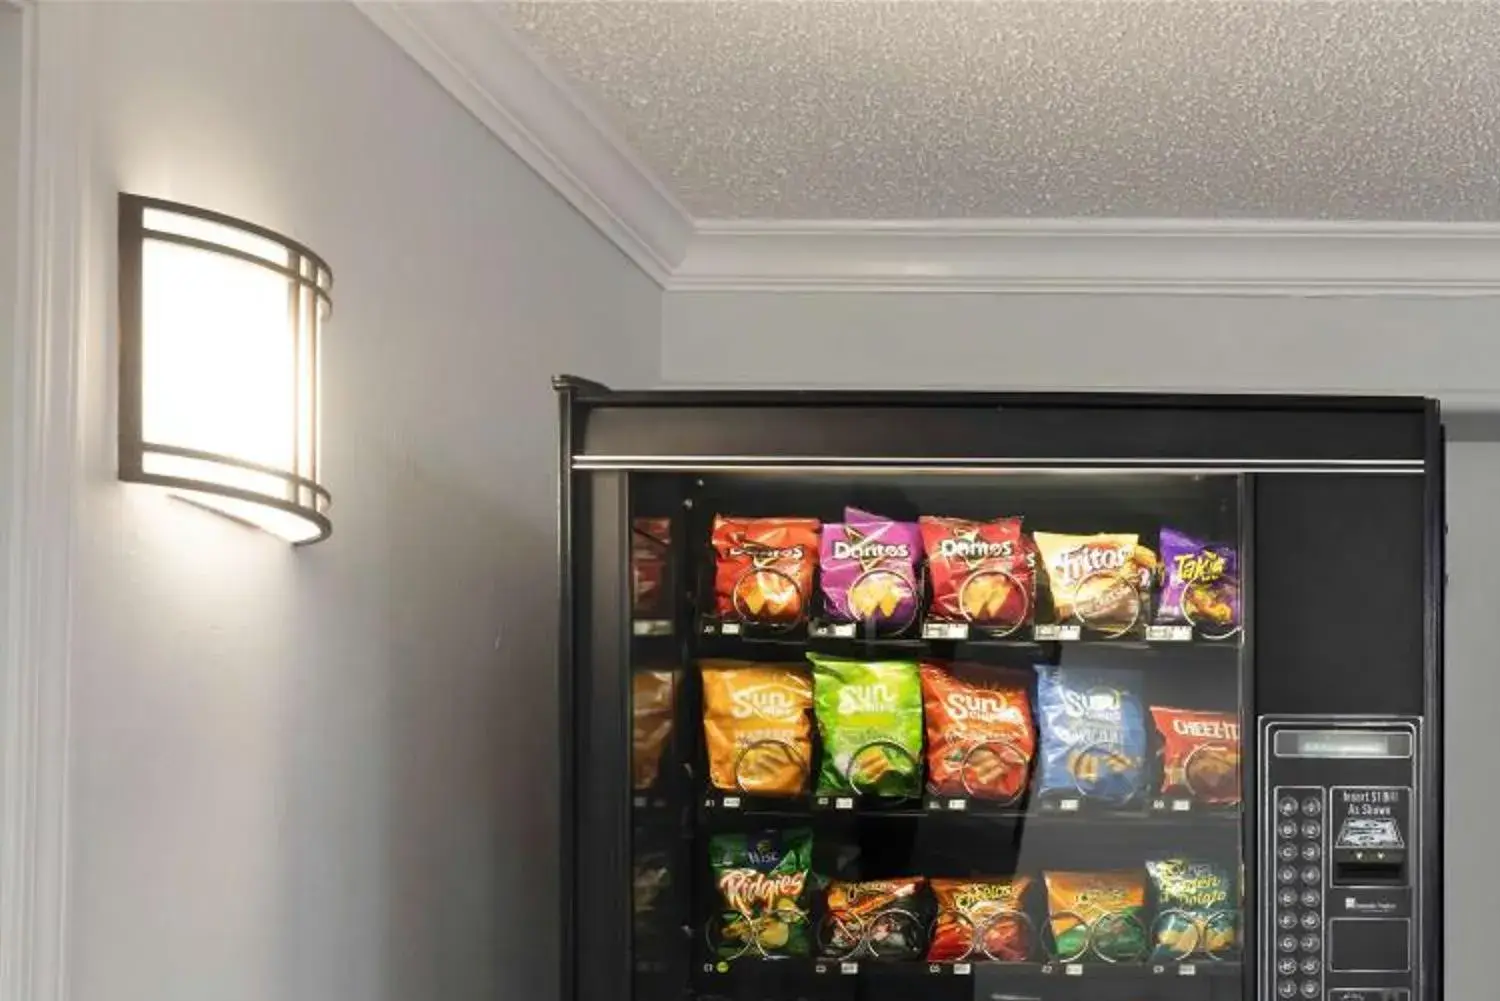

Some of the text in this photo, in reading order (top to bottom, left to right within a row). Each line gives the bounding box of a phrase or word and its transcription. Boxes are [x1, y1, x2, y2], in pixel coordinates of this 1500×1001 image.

[833, 540, 909, 560] Doritos
[732, 688, 794, 718] Sun
[838, 684, 899, 714] Sun
[946, 692, 1006, 720] Sun
